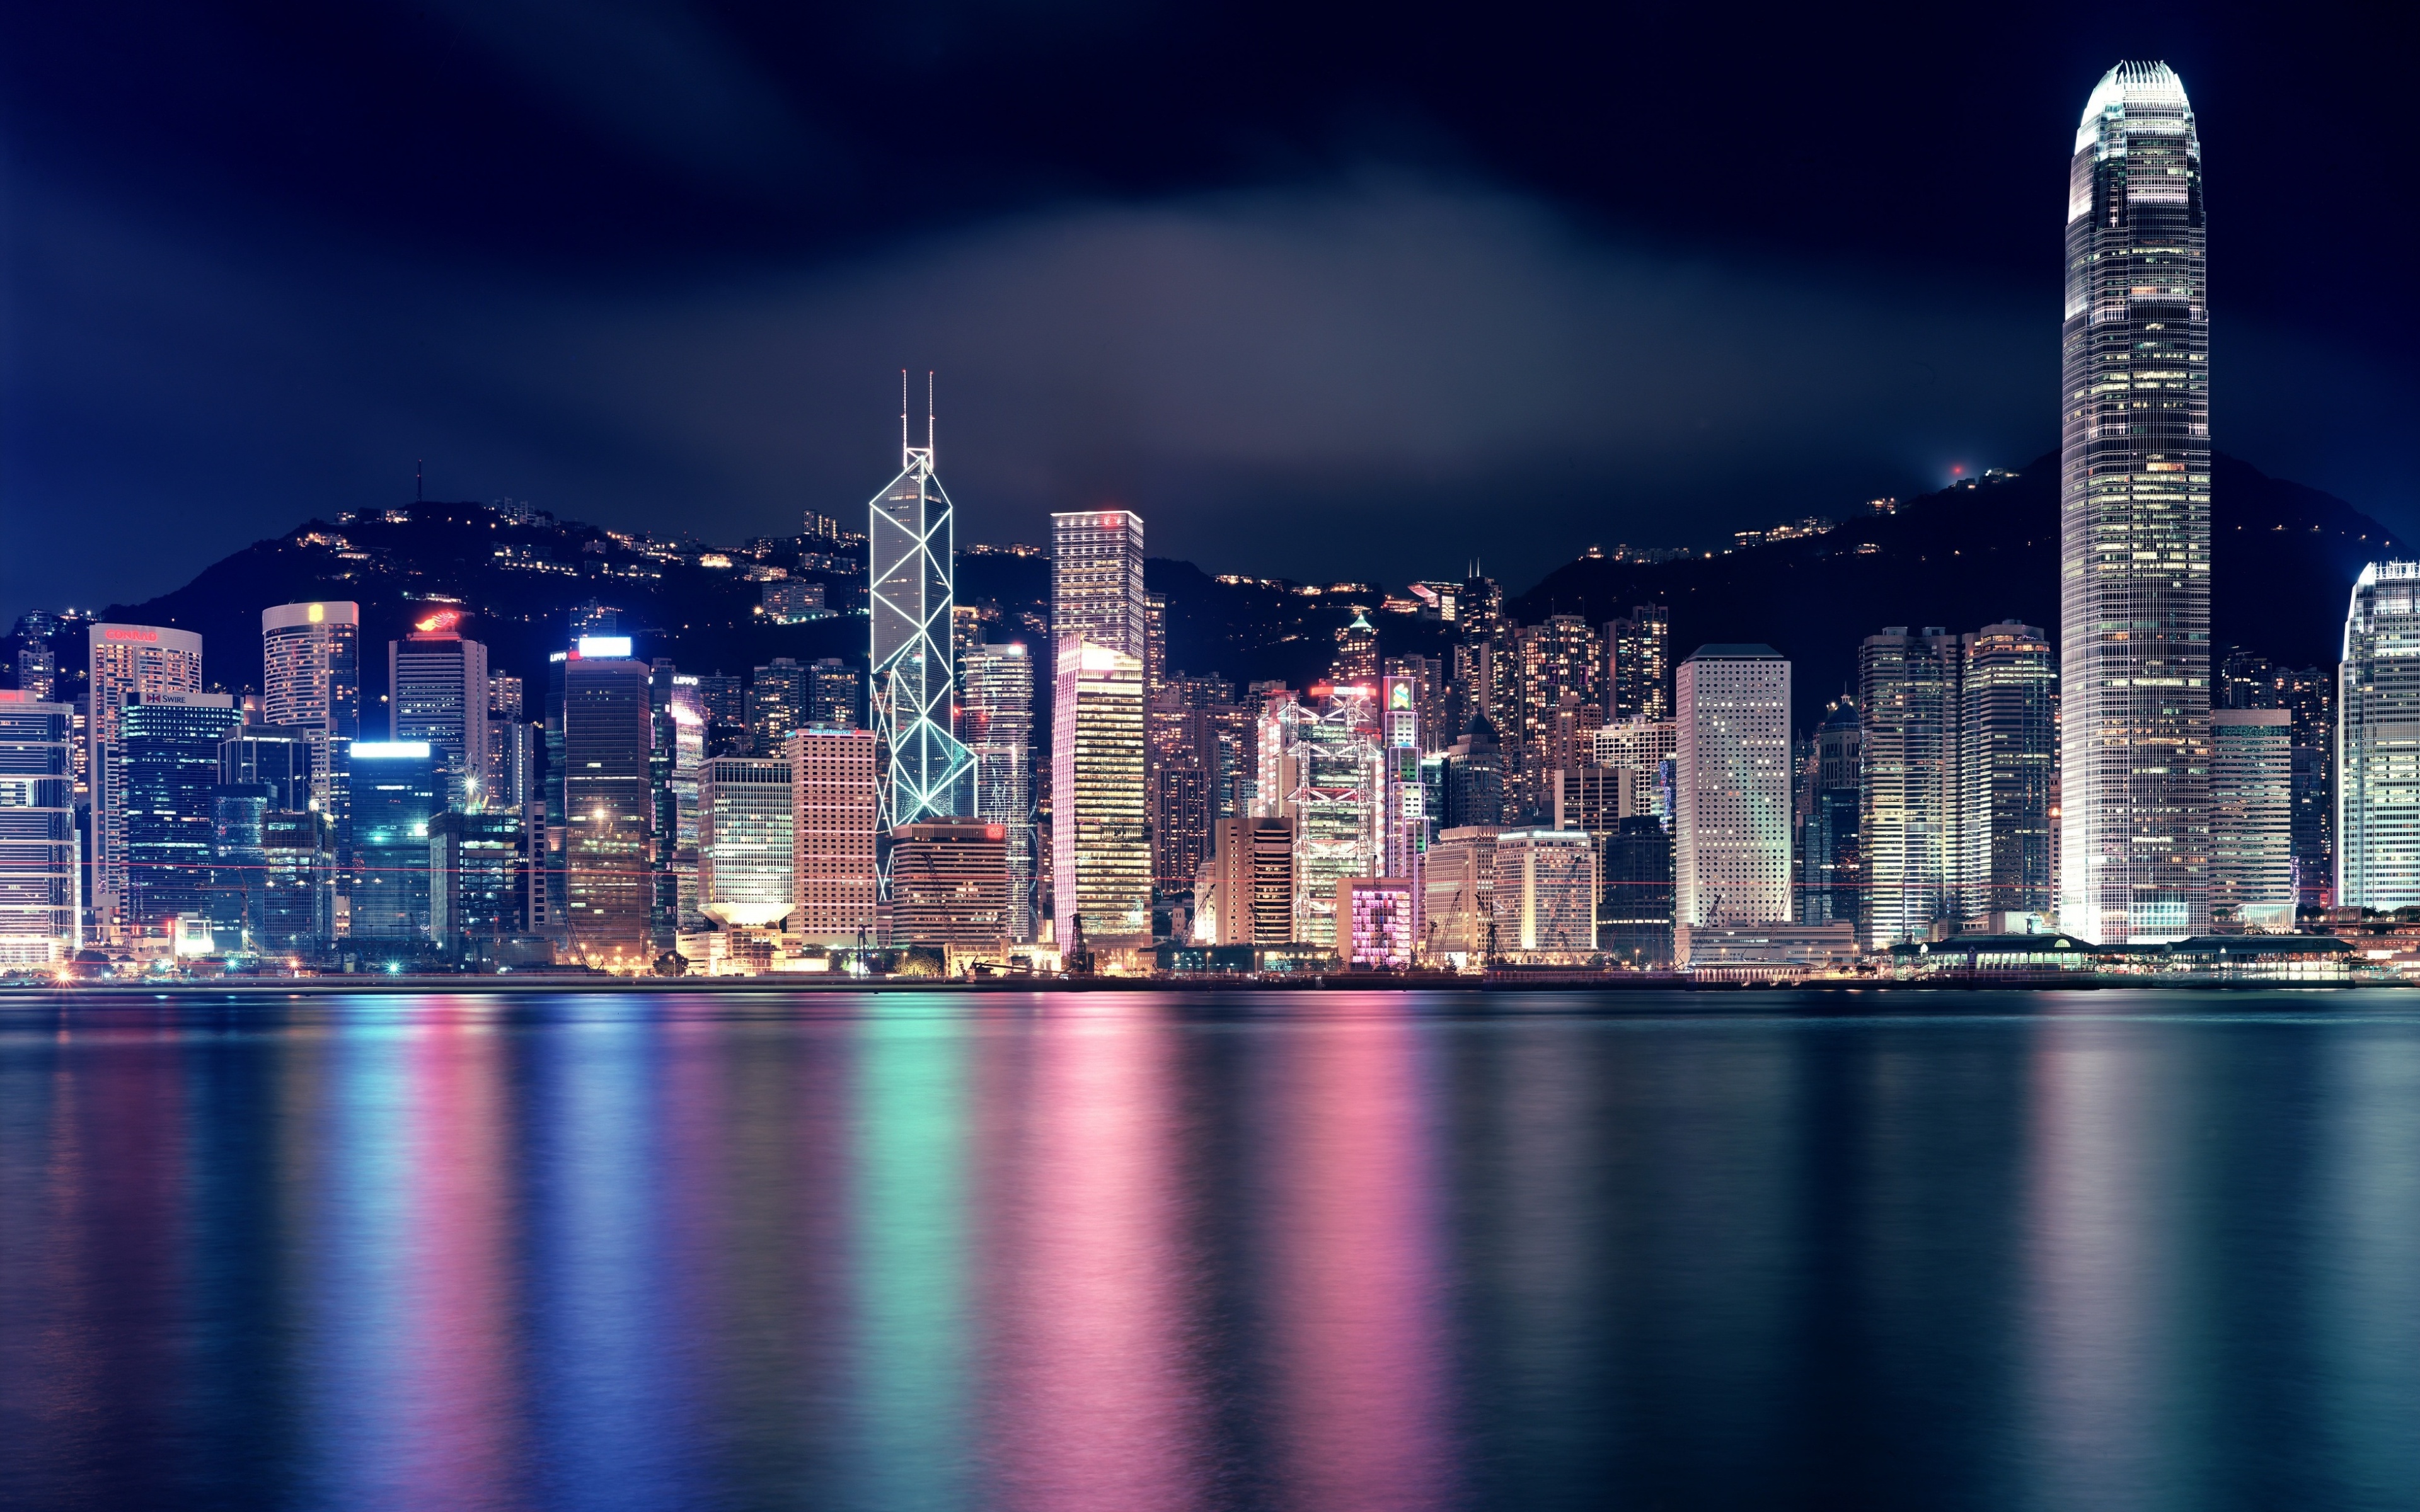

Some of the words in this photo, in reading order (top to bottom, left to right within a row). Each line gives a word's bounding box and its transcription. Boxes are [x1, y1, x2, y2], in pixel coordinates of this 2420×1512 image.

[105, 630, 158, 642] CONRAD
[550, 651, 567, 662] LIPPO
[673, 676, 698, 685] LIPPO
